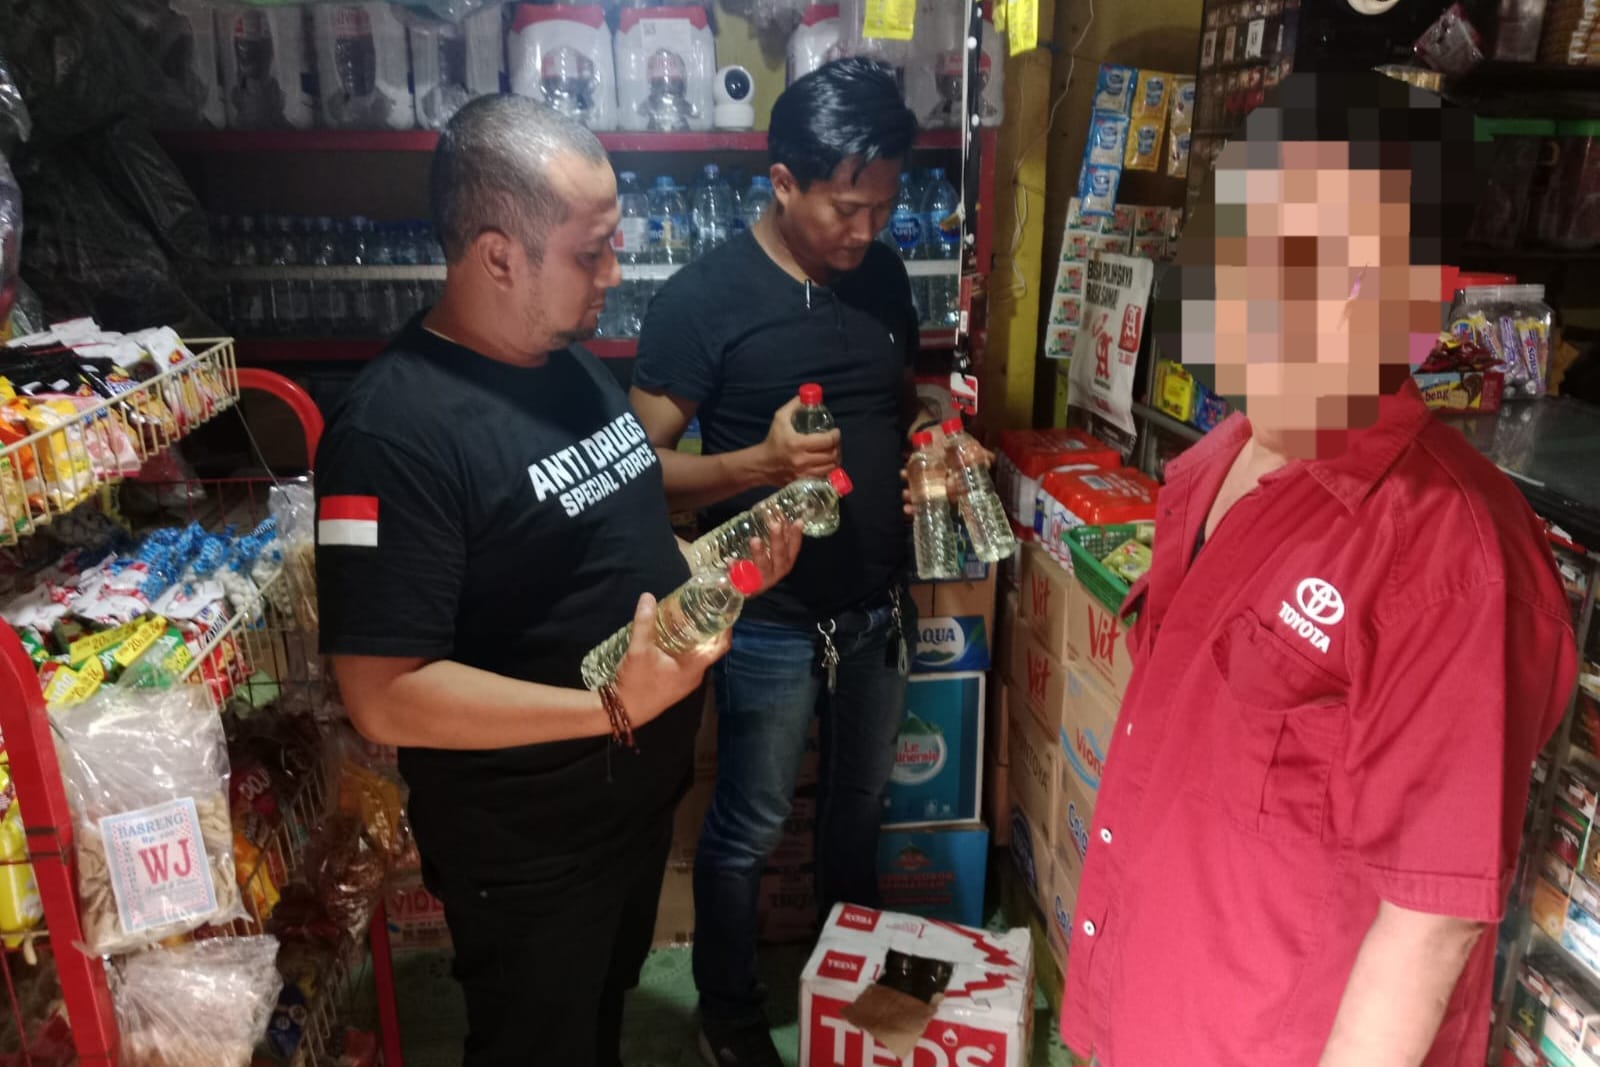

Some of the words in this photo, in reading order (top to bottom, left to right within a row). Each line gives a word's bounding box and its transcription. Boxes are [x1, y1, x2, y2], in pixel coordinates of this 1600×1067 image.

[527, 446, 589, 502] ANTI
[580, 412, 646, 469] DRUGS
[559, 471, 620, 518] SPECIAL
[615, 443, 657, 484] FORCE
[1088, 603, 1121, 666] Vit
[1278, 600, 1331, 654] TOYOTA
[1027, 647, 1051, 700] Vit
[118, 813, 184, 838] BASRENG
[138, 838, 192, 885] WJ
